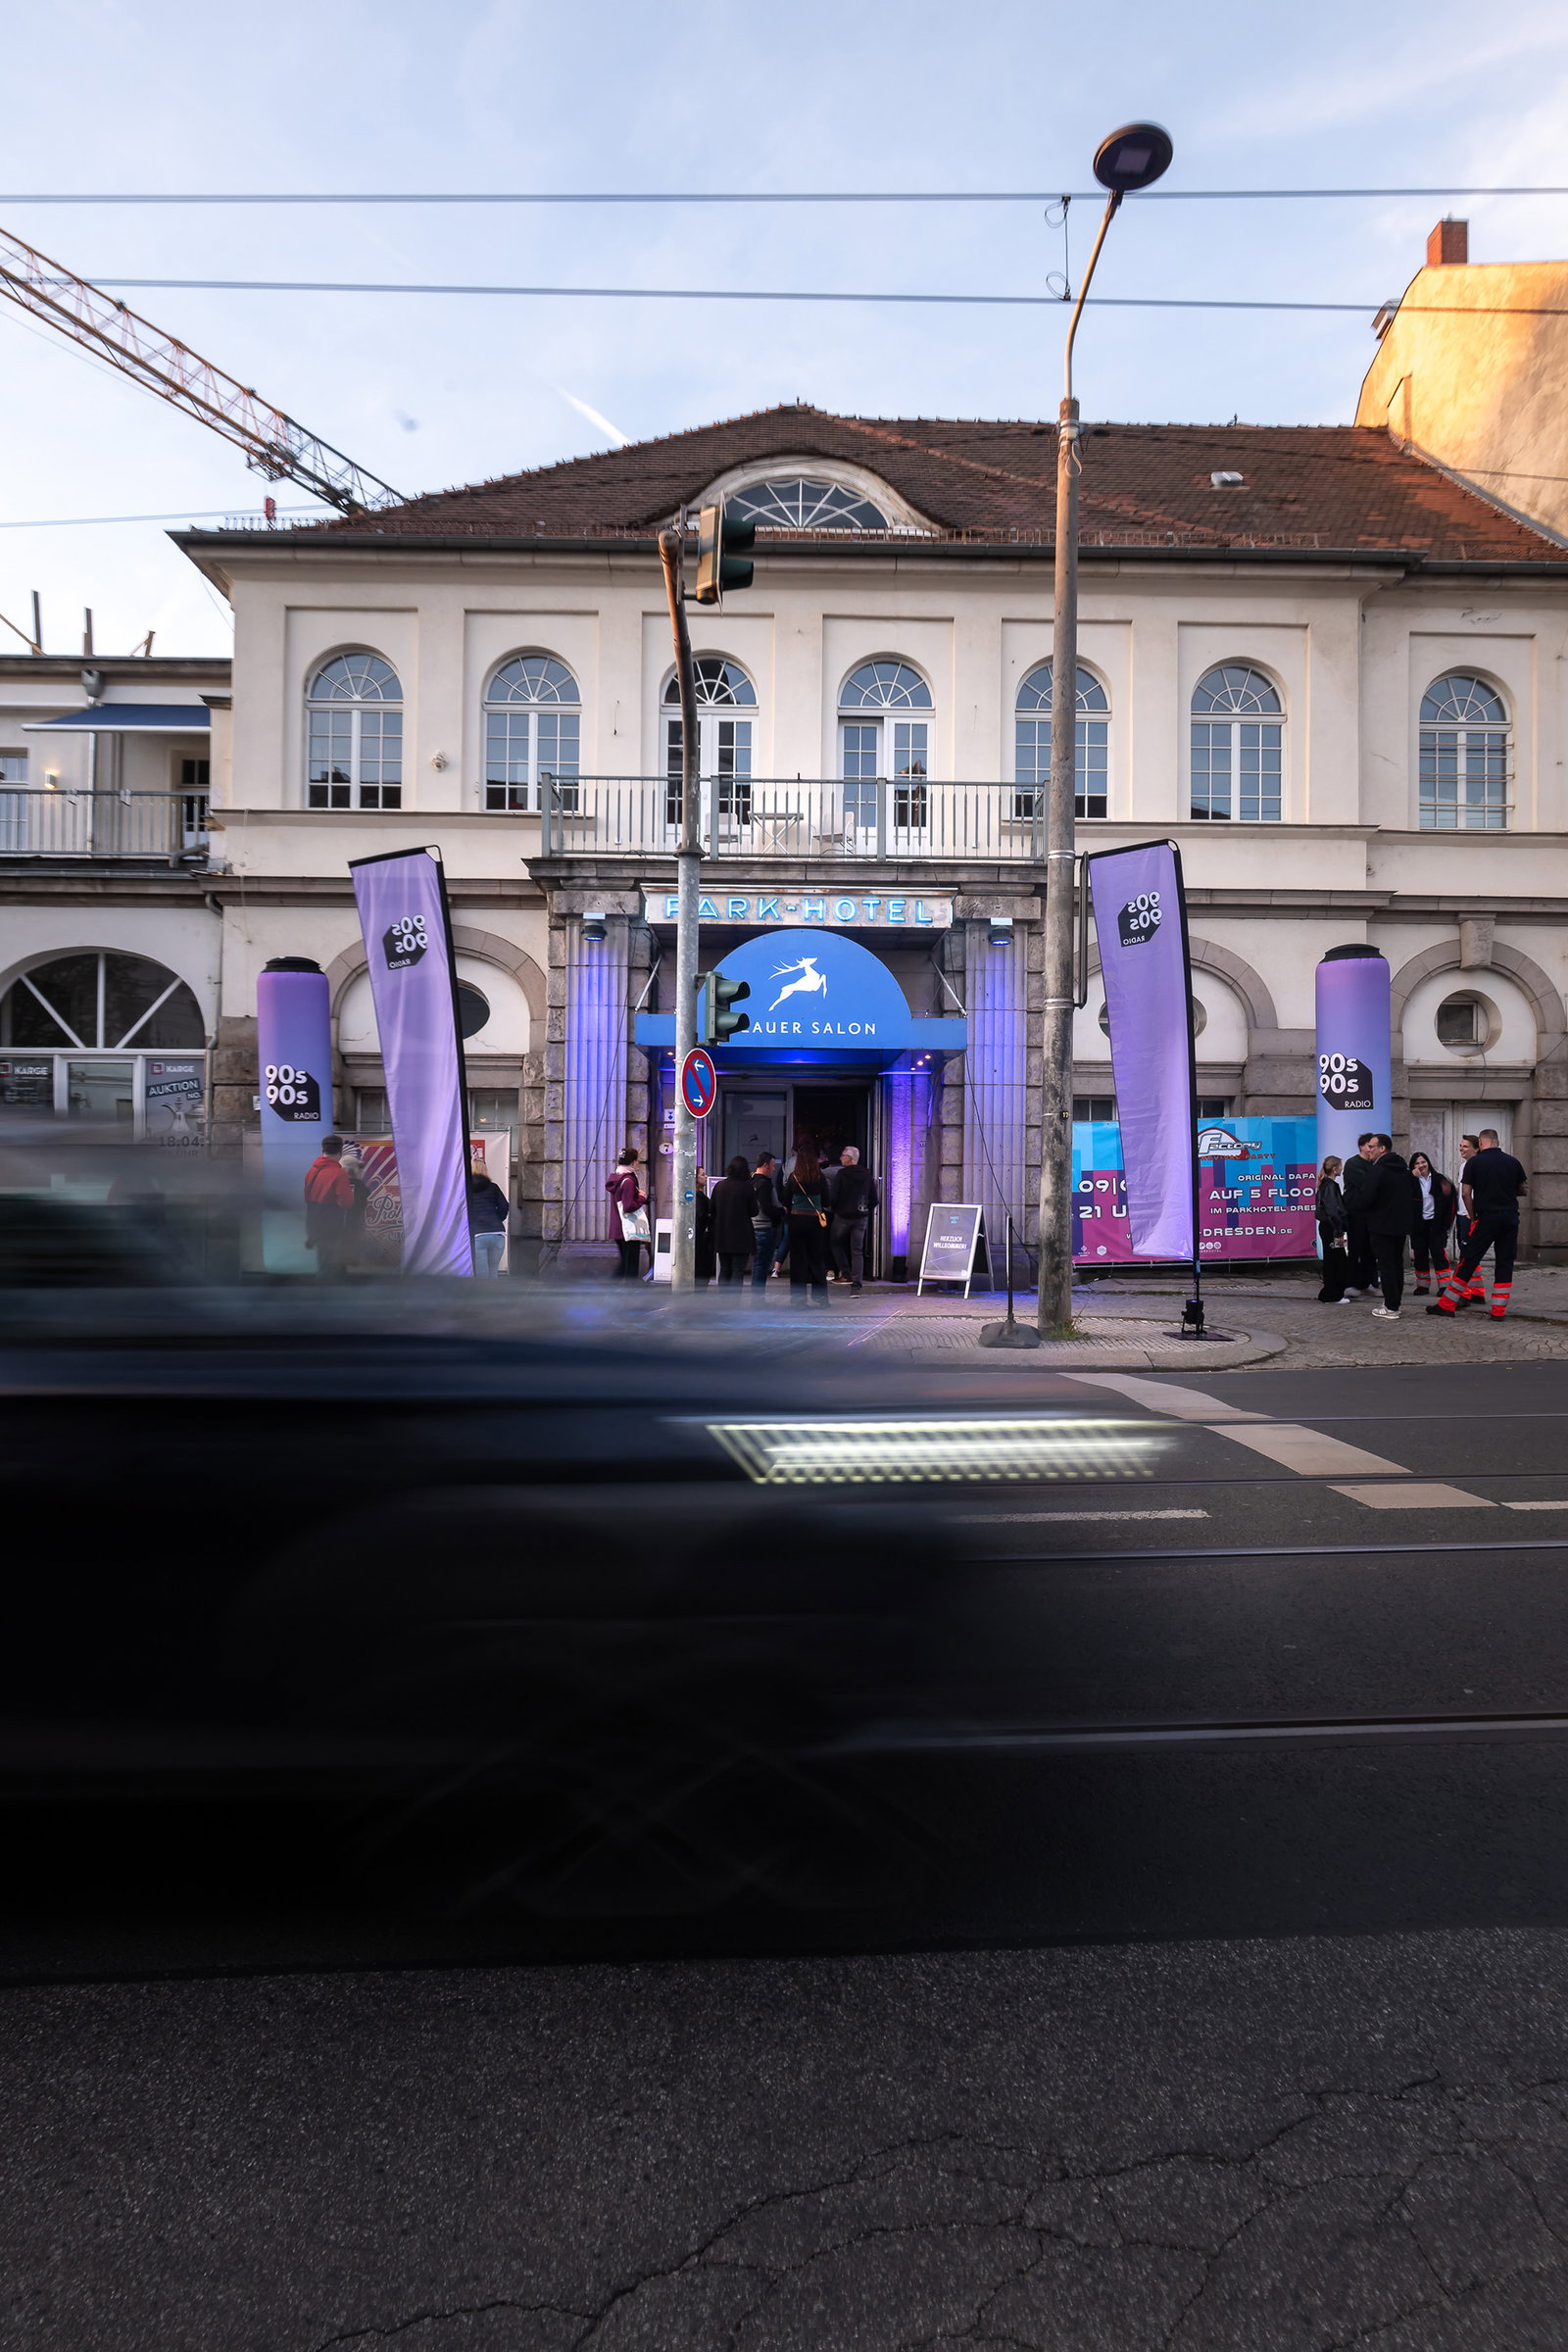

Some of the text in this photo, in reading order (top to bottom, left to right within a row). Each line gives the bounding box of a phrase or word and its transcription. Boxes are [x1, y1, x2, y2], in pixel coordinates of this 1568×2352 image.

[664, 897, 933, 923] PARK-HOTEL
[741, 1021, 876, 1035] AUER SALON
[14, 1066, 48, 1075] KARGE
[1319, 1054, 1358, 1073] 90s
[265, 1064, 308, 1084] 90s
[149, 1079, 199, 1096] AUKTION
[1319, 1073, 1359, 1094] 90s
[266, 1085, 309, 1104] 90s
[1209, 1188, 1318, 1200] AUF 5 FLOO
[1079, 1205, 1102, 1219] 21
